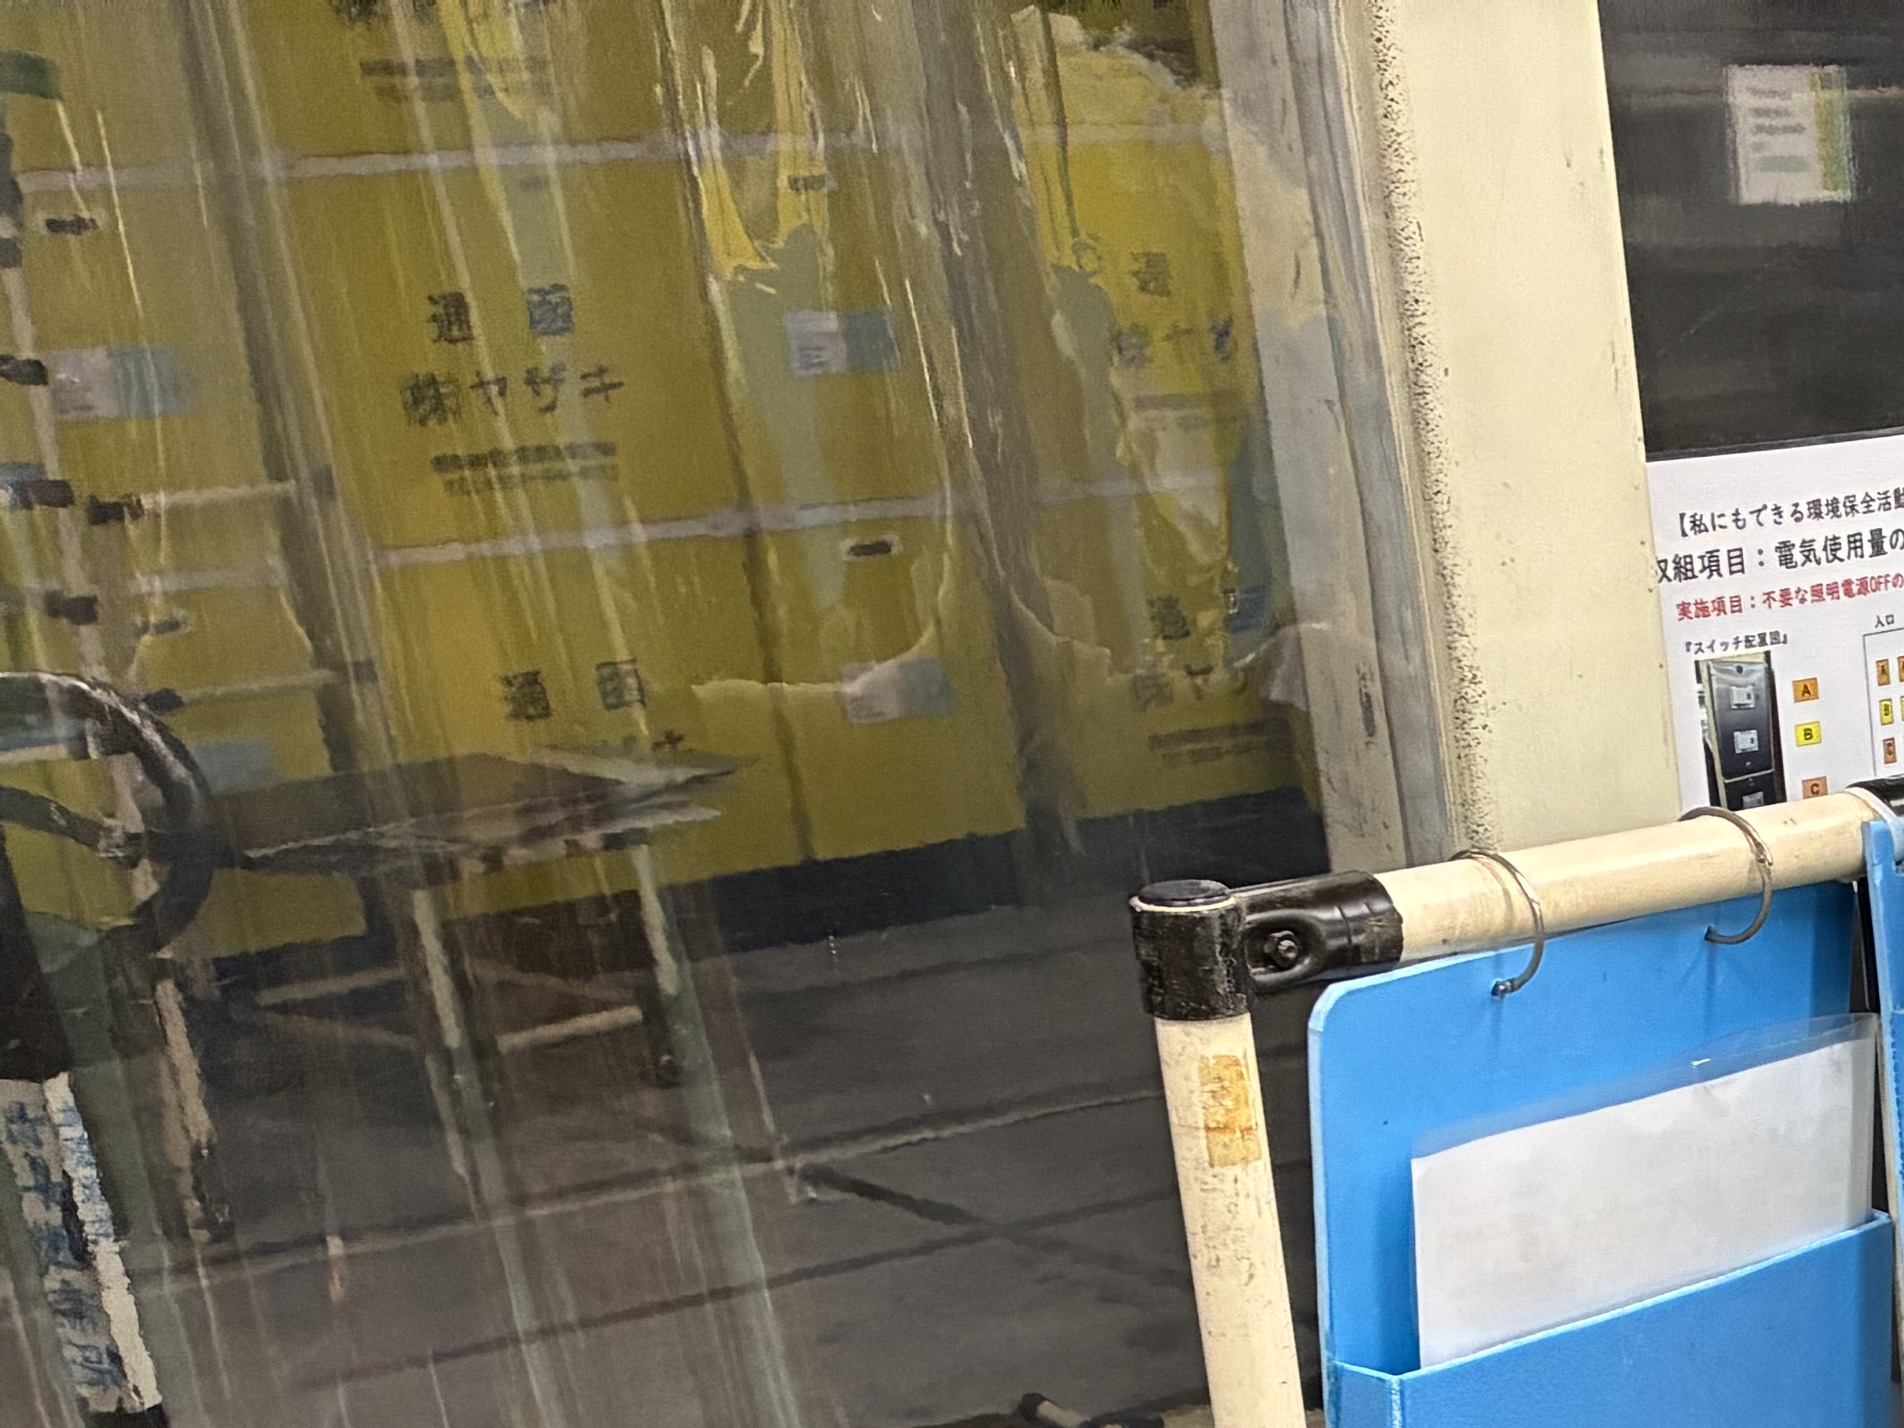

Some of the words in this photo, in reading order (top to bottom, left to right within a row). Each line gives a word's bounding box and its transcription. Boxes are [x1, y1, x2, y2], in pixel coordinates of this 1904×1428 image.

[1802, 684, 1811, 696] A
[1804, 728, 1813, 740] B
[1811, 783, 1819, 796] C
